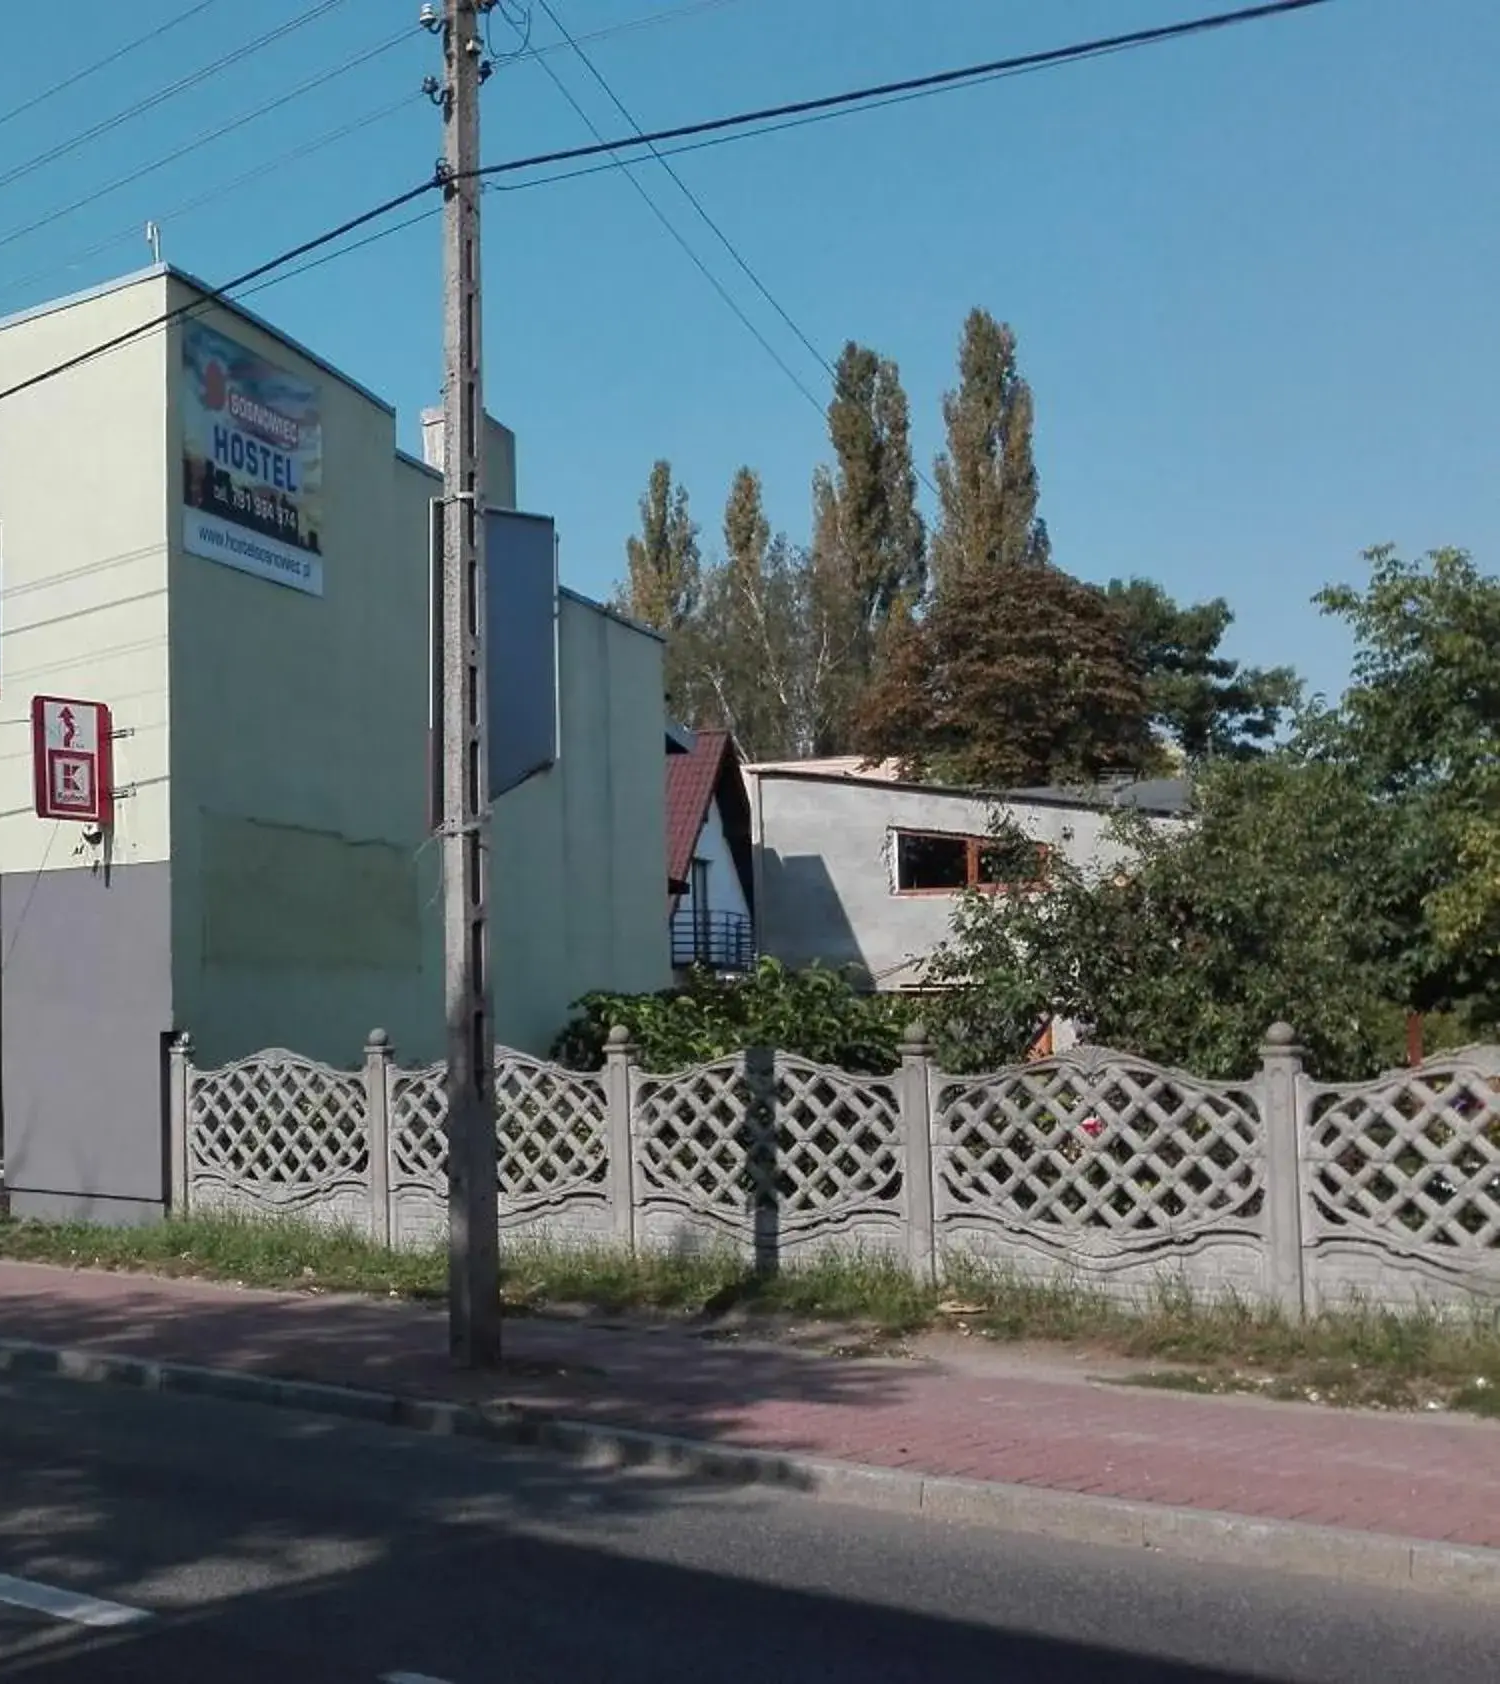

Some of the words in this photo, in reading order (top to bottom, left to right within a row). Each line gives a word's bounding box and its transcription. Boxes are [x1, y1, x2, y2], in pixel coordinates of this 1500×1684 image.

[230, 393, 298, 443] SOSNOWIEC
[213, 424, 298, 493] HOSTEL
[63, 763, 80, 791] K
